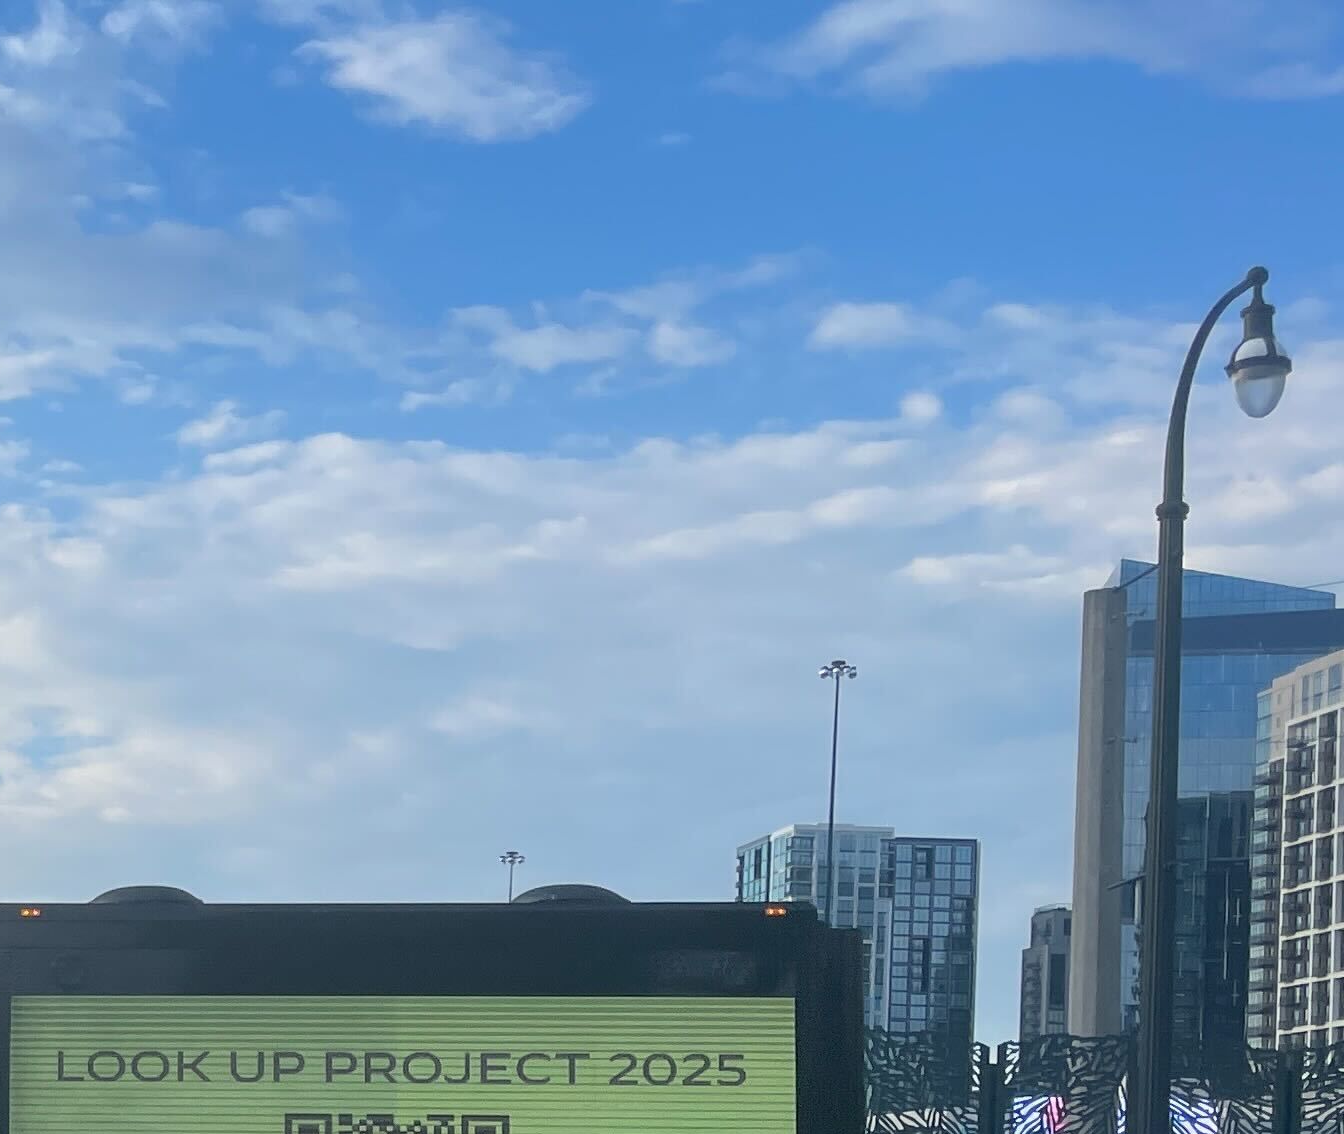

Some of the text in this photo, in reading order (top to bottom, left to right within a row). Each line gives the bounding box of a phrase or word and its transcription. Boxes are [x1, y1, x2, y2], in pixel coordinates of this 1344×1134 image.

[55, 1050, 748, 1087] LOOK UP PROJECT 2025
